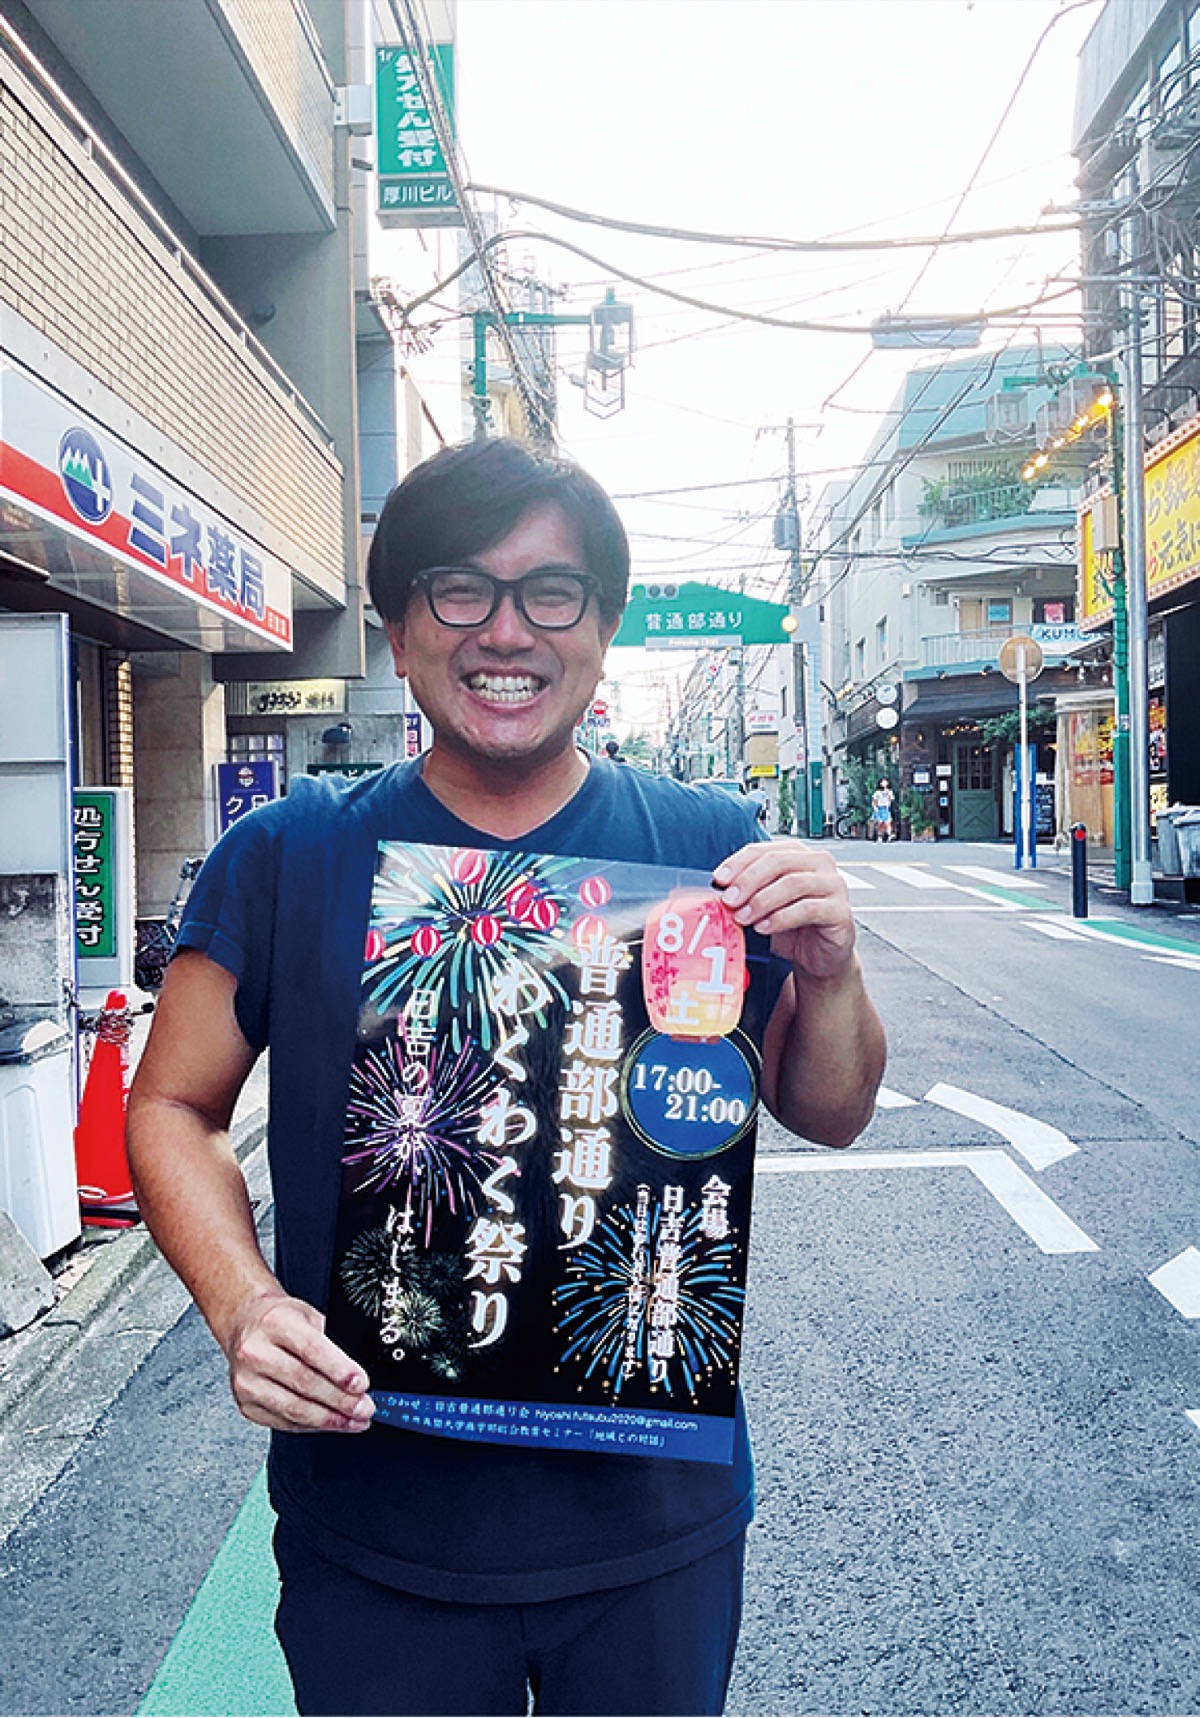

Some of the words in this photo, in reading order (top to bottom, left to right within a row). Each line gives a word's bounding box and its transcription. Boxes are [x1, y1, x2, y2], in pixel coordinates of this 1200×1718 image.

[383, 184, 453, 204] 厚川ビル
[130, 472, 265, 620] ミネ薬局
[645, 611, 743, 630] 普通部通り
[657, 912, 734, 996] 8/1
[665, 990, 700, 1025] 土
[551, 932, 632, 1250] 普通部通り
[634, 1063, 722, 1095] 17:00-
[664, 1094, 746, 1126] 21:00
[462, 958, 552, 1349] わくわく祭り
[648, 1184, 685, 1384] 日吉普通部通り
